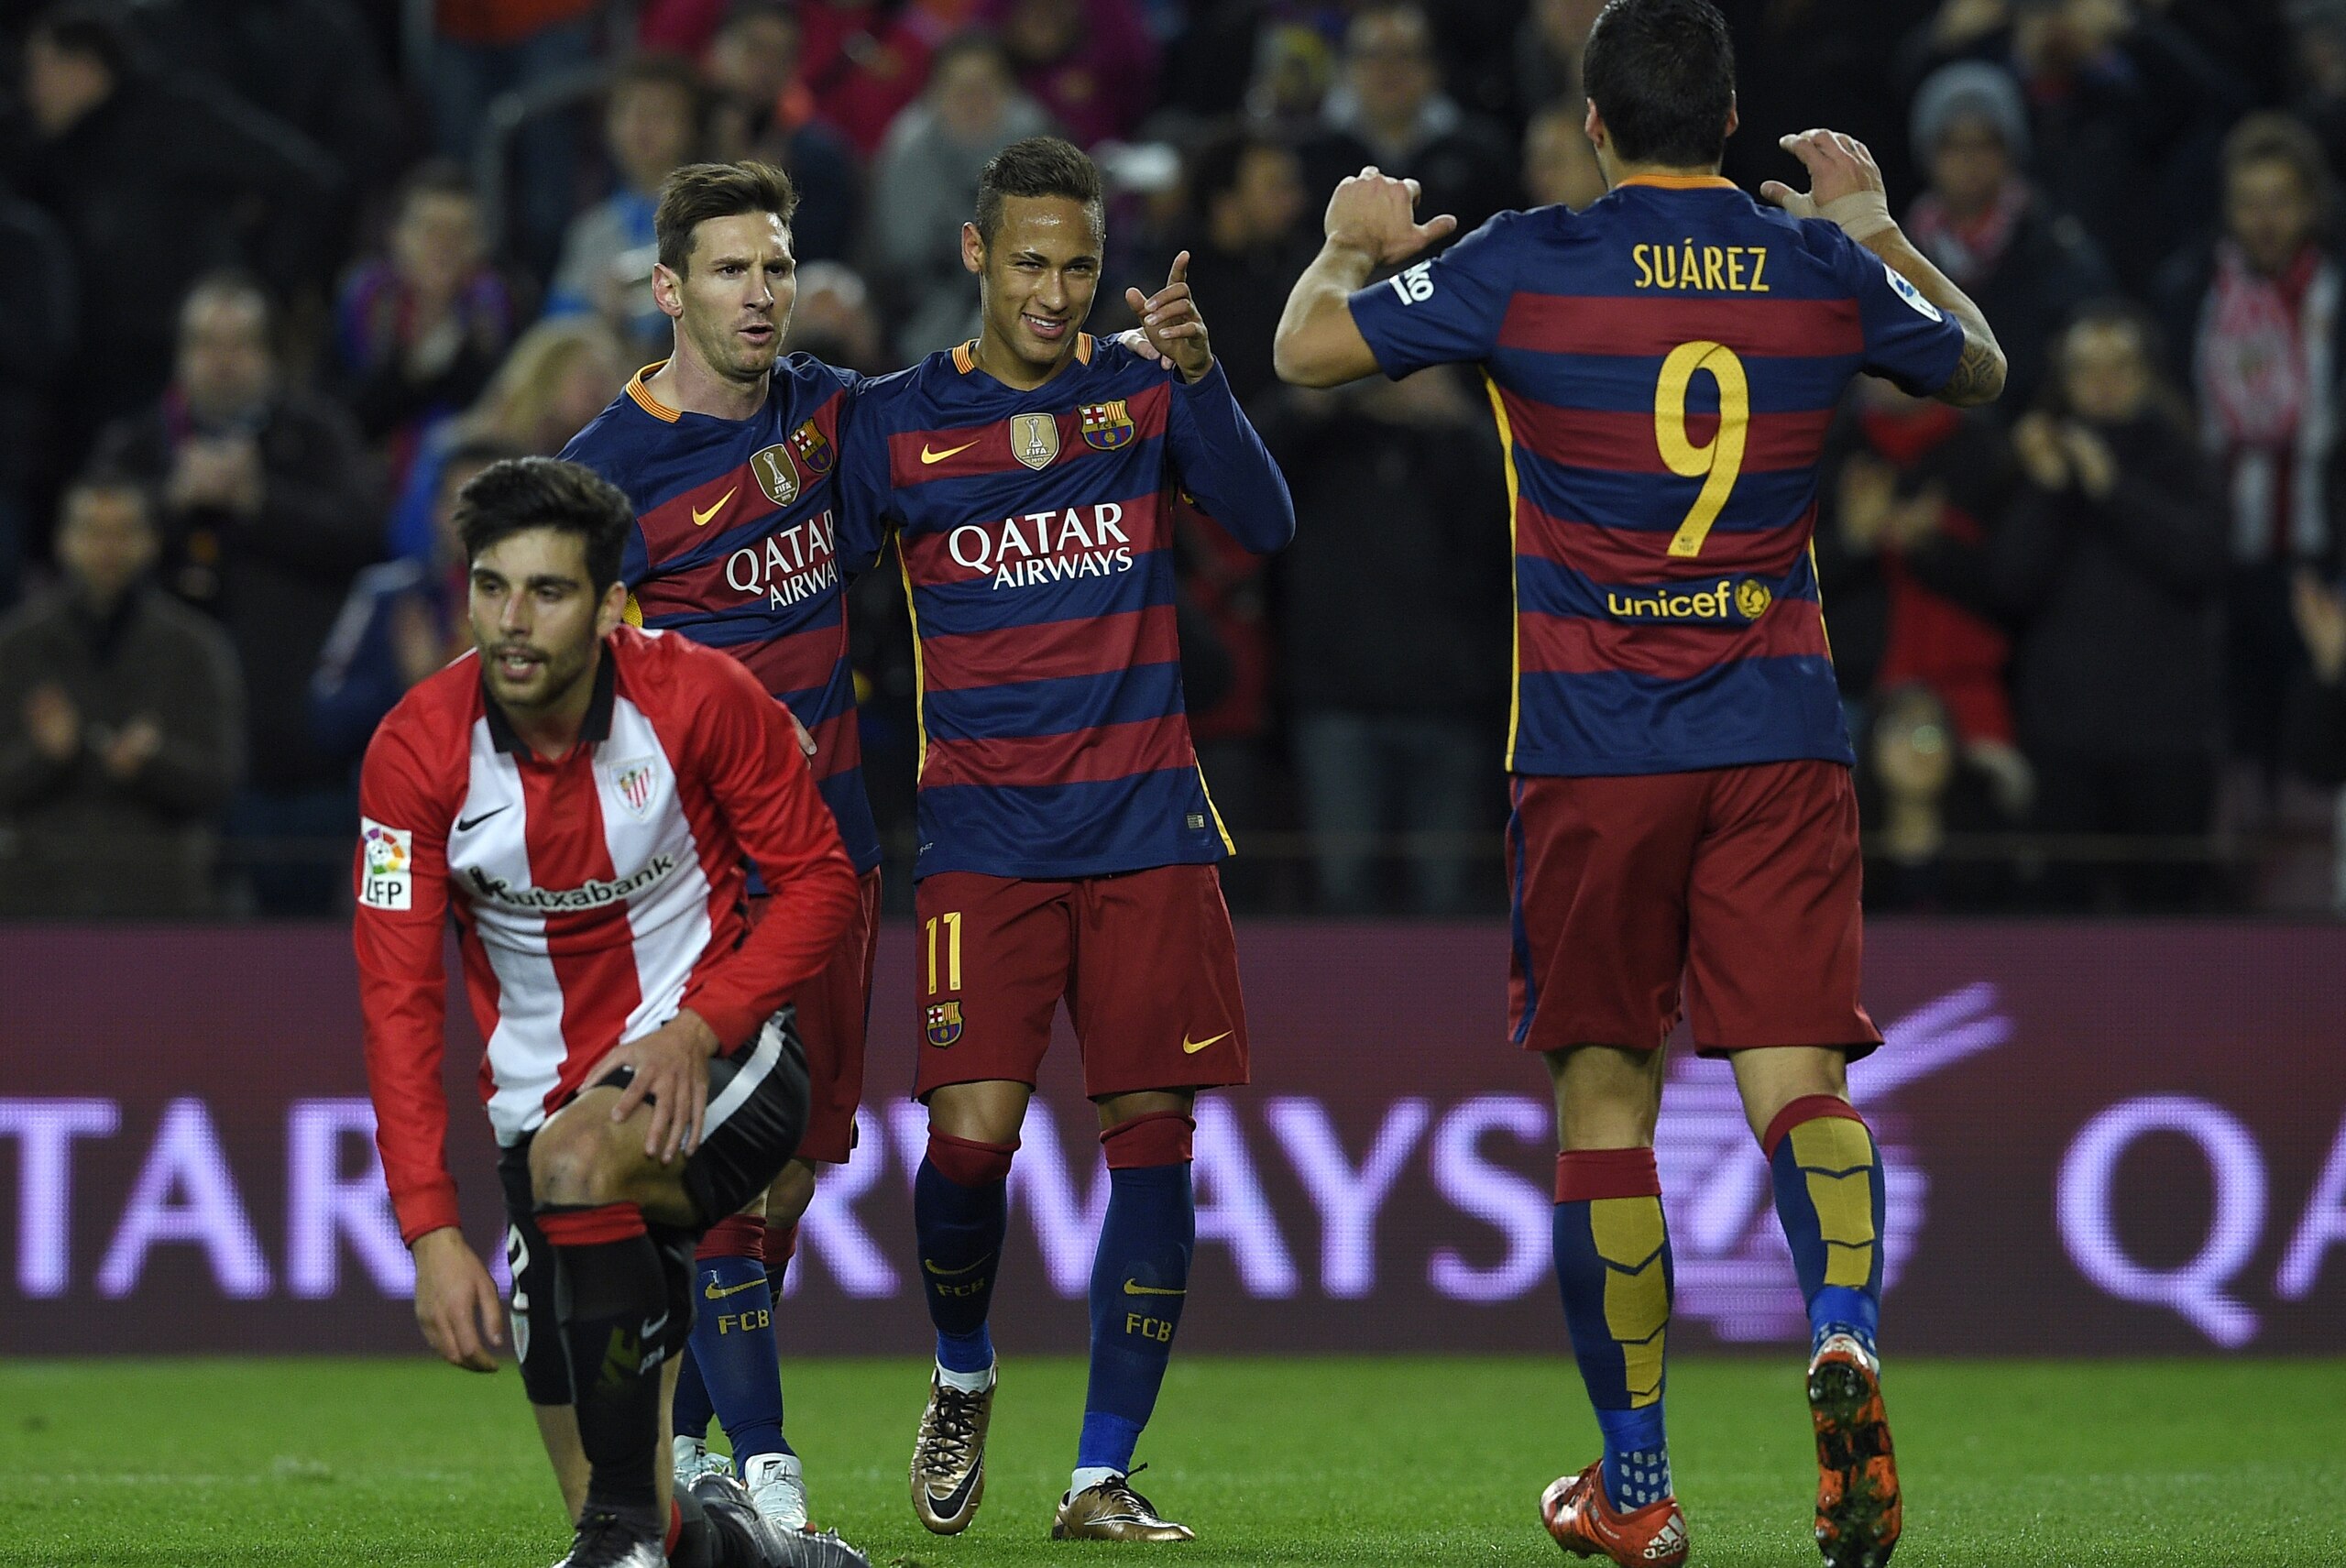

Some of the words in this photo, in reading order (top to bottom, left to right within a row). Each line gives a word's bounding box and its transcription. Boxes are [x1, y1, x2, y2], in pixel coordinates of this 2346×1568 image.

[1633, 237, 1770, 291] SUÁREZ
[1025, 447, 1047, 456] FIFA
[1654, 340, 1749, 558] 9
[773, 481, 793, 495] FIFA
[948, 502, 1130, 575] QATAR
[992, 546, 1133, 590] AIRWAYS
[1608, 579, 1731, 619] unicef
[367, 877, 402, 906] LFP
[926, 911, 961, 996] 11
[936, 1277, 984, 1298] FCB
[718, 1310, 770, 1335] FCB
[1125, 1312, 1173, 1343] FCB
